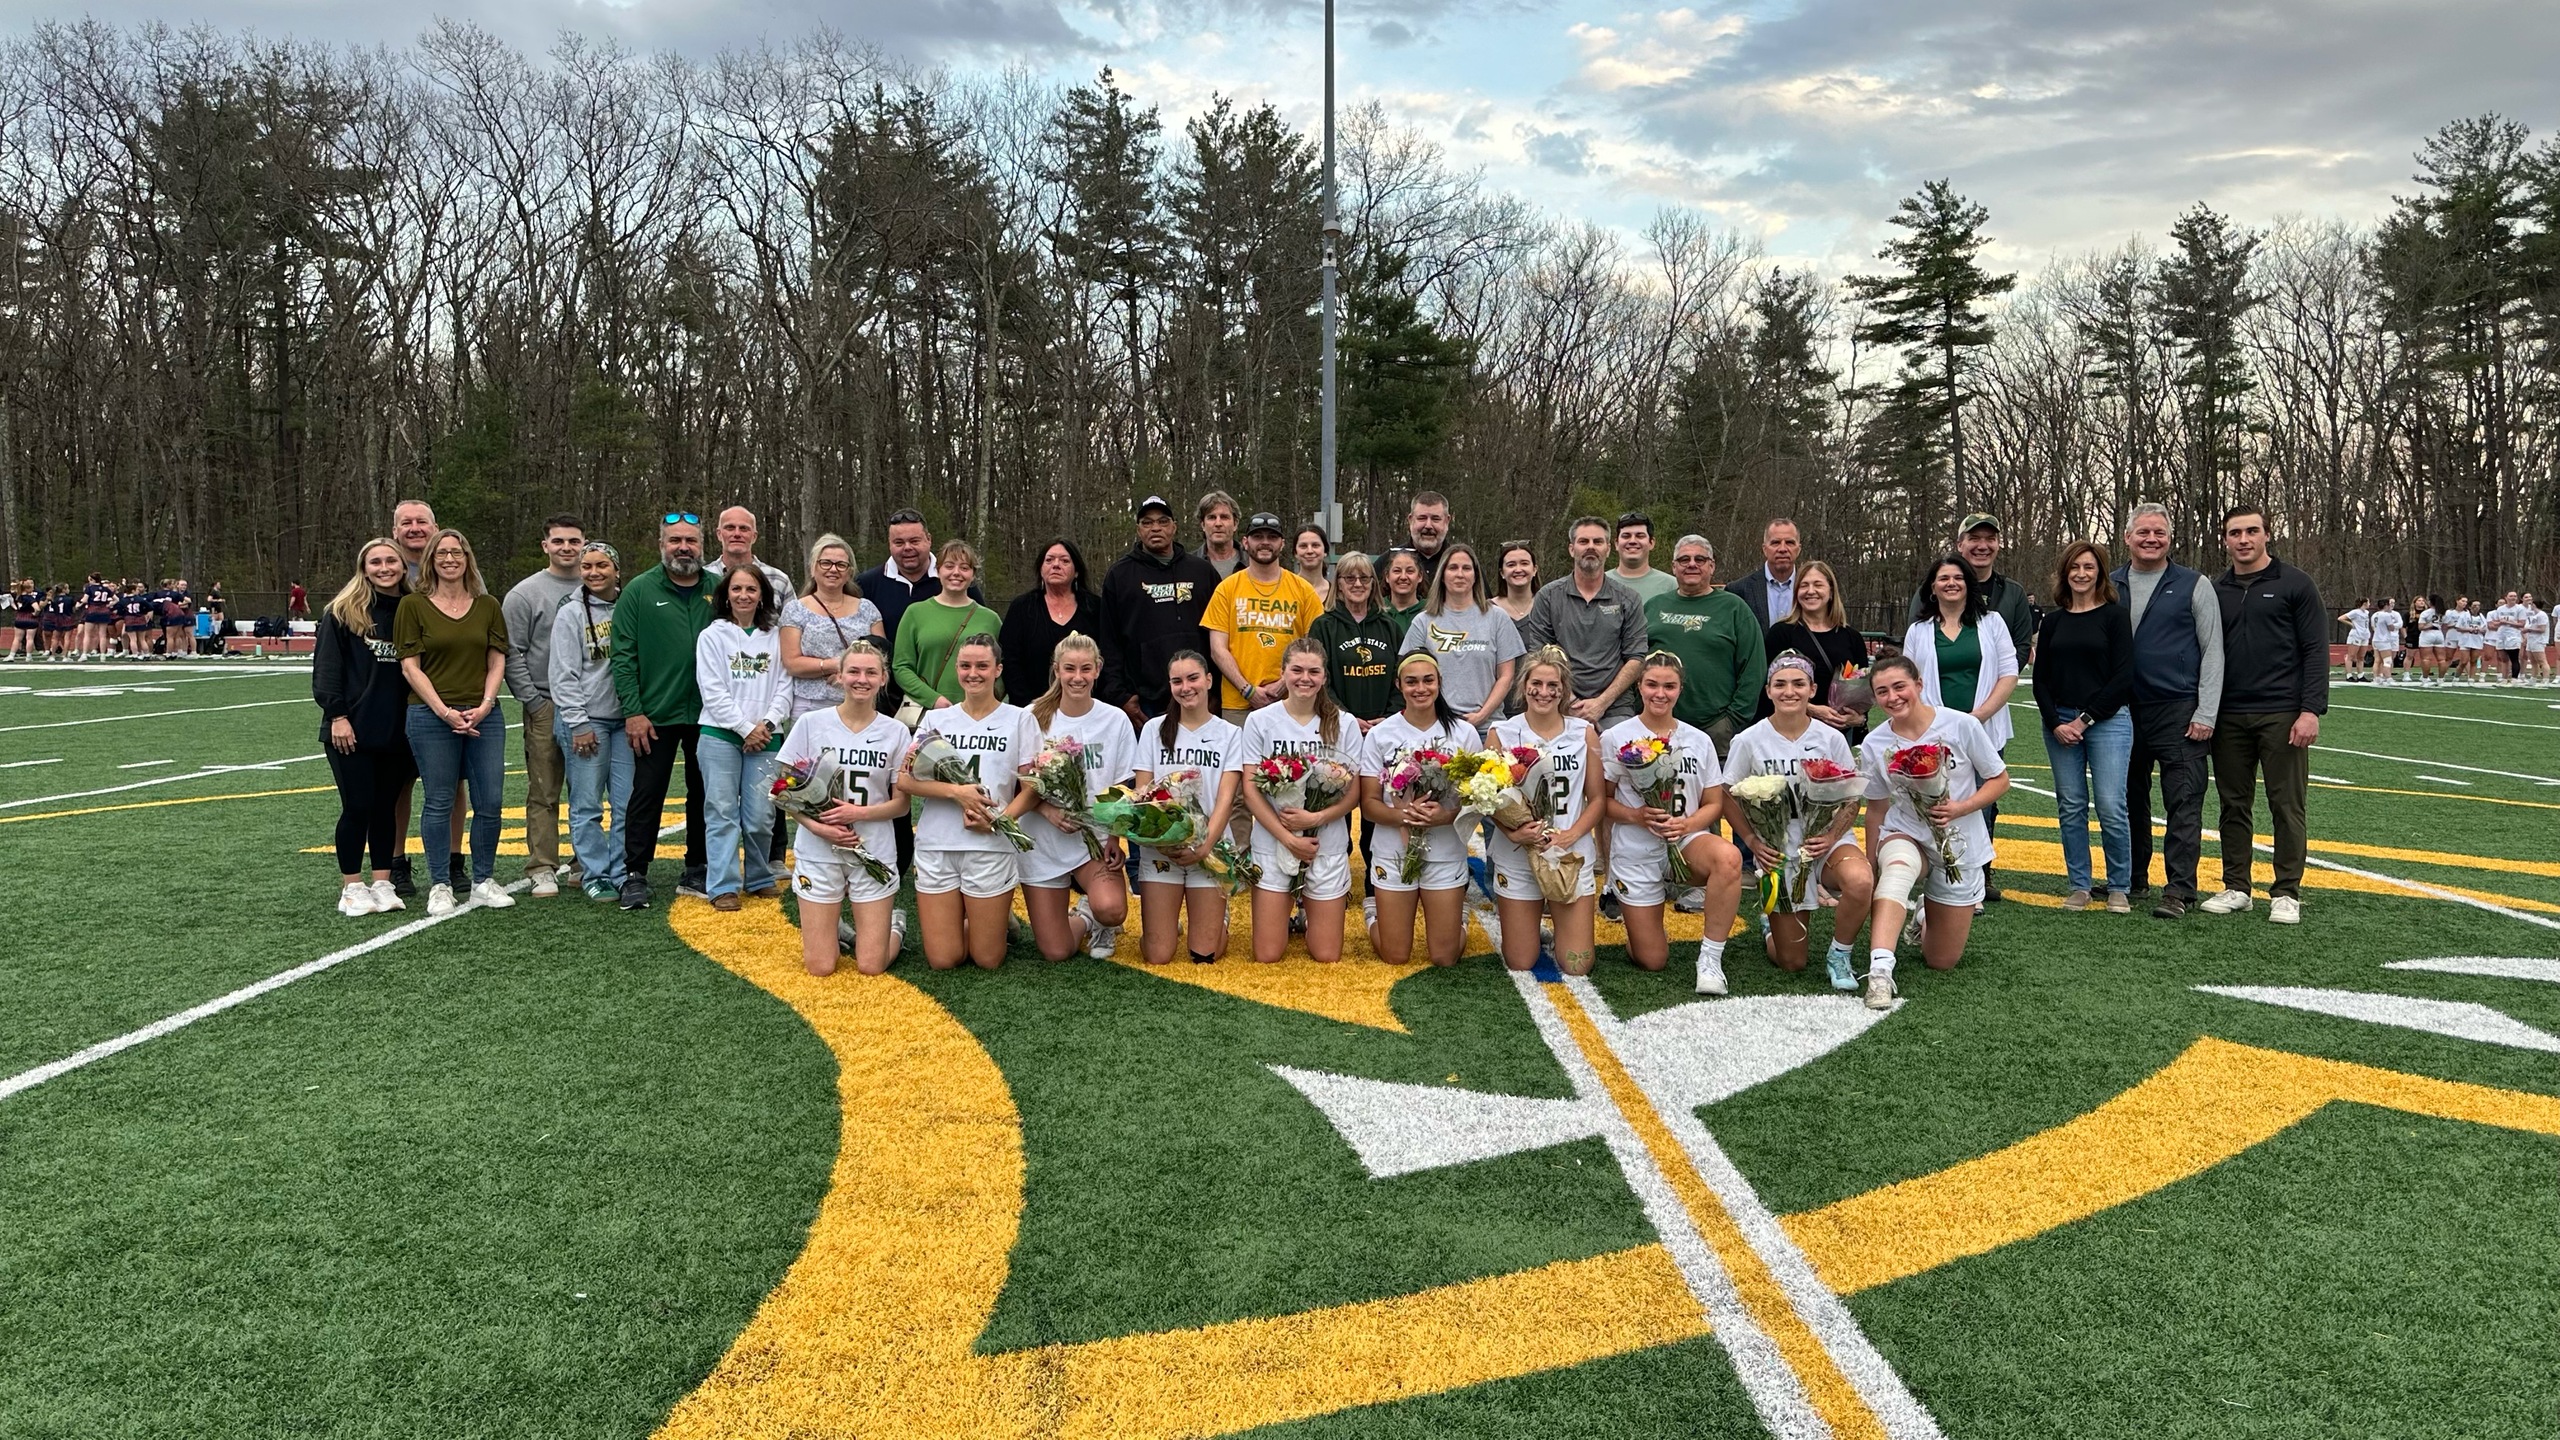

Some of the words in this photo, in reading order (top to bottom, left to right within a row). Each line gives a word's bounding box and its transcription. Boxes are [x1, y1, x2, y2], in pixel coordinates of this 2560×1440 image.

[93, 591, 108, 602] 20
[1236, 598, 1247, 625] ONE
[1248, 598, 1298, 614] TEAM
[1247, 612, 1296, 628] FAMILY
[821, 746, 888, 769] LCONS
[1160, 748, 1221, 768] FALCONS
